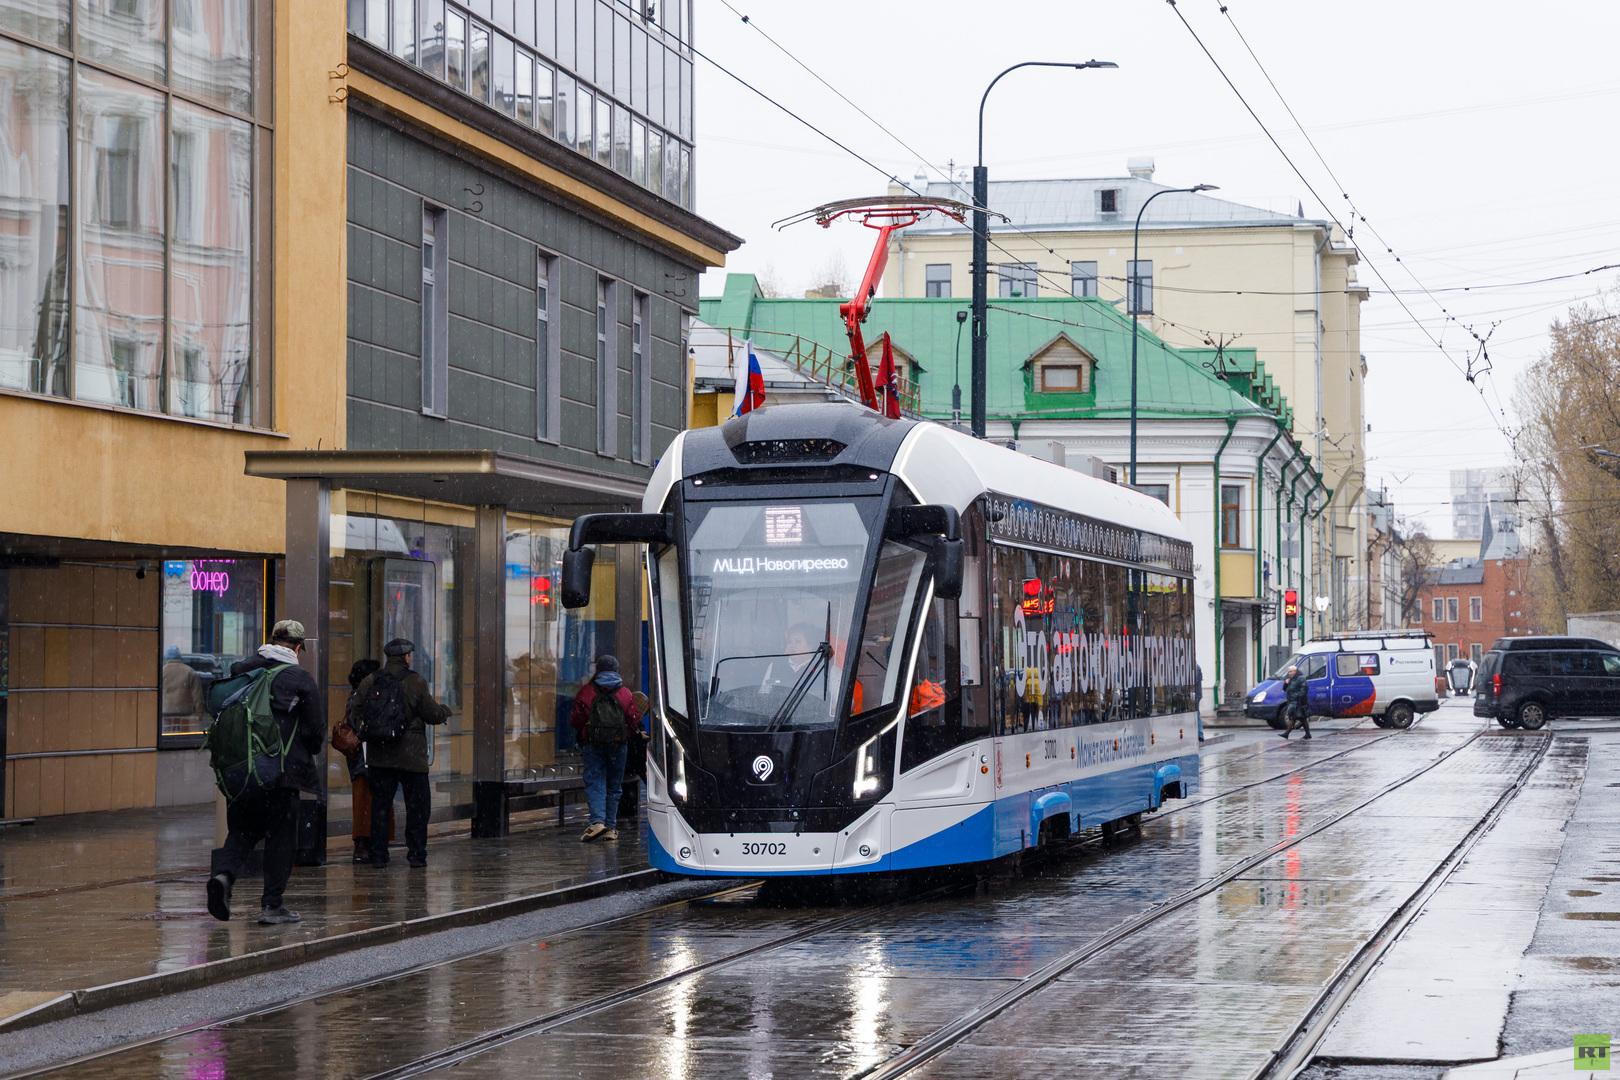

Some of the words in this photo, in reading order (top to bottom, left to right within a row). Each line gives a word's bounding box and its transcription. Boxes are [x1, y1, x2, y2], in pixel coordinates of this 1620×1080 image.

[713, 558, 754, 575] МЦД
[756, 557, 849, 573] Новогиреево
[191, 564, 229, 597] донер
[1286, 605, 1297, 614] 24
[1014, 604, 1048, 698] Это
[1053, 614, 1144, 694] автономный
[1044, 739, 1057, 760] 30702
[1077, 736, 1099, 769] Может
[742, 843, 786, 855] 30702
